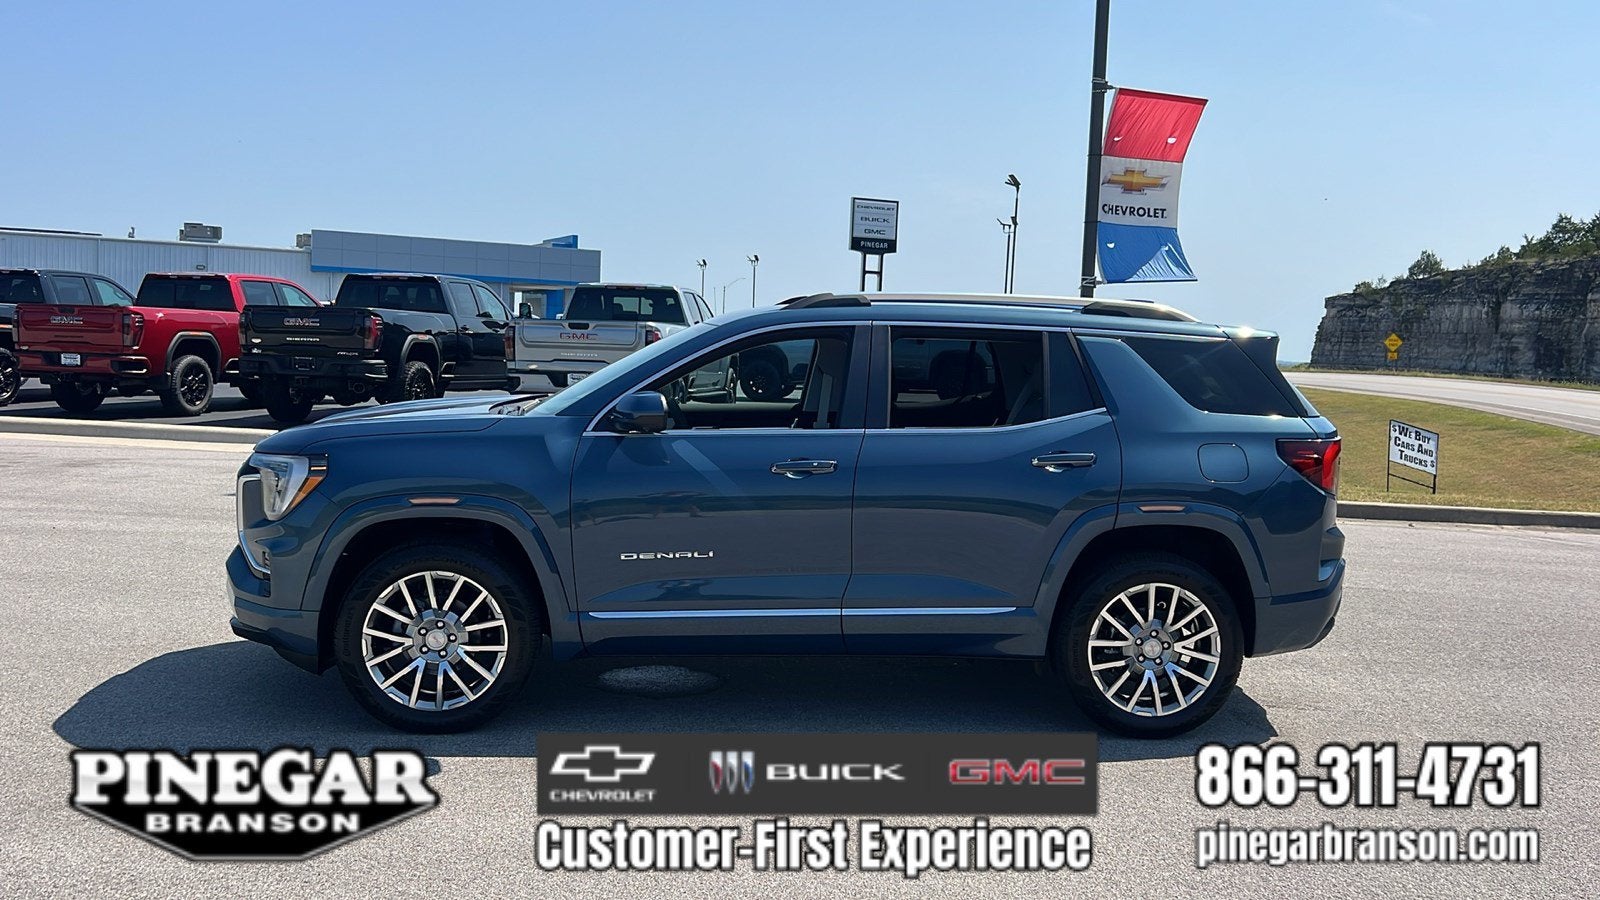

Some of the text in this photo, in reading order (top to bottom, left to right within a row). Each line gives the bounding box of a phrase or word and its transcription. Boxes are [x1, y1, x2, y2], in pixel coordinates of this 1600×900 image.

[1102, 203, 1166, 219] CHEVROLET
[50, 315, 83, 324] GMC
[283, 317, 320, 326] GMC
[559, 332, 598, 341] GMC
[620, 550, 715, 560] DENALI
